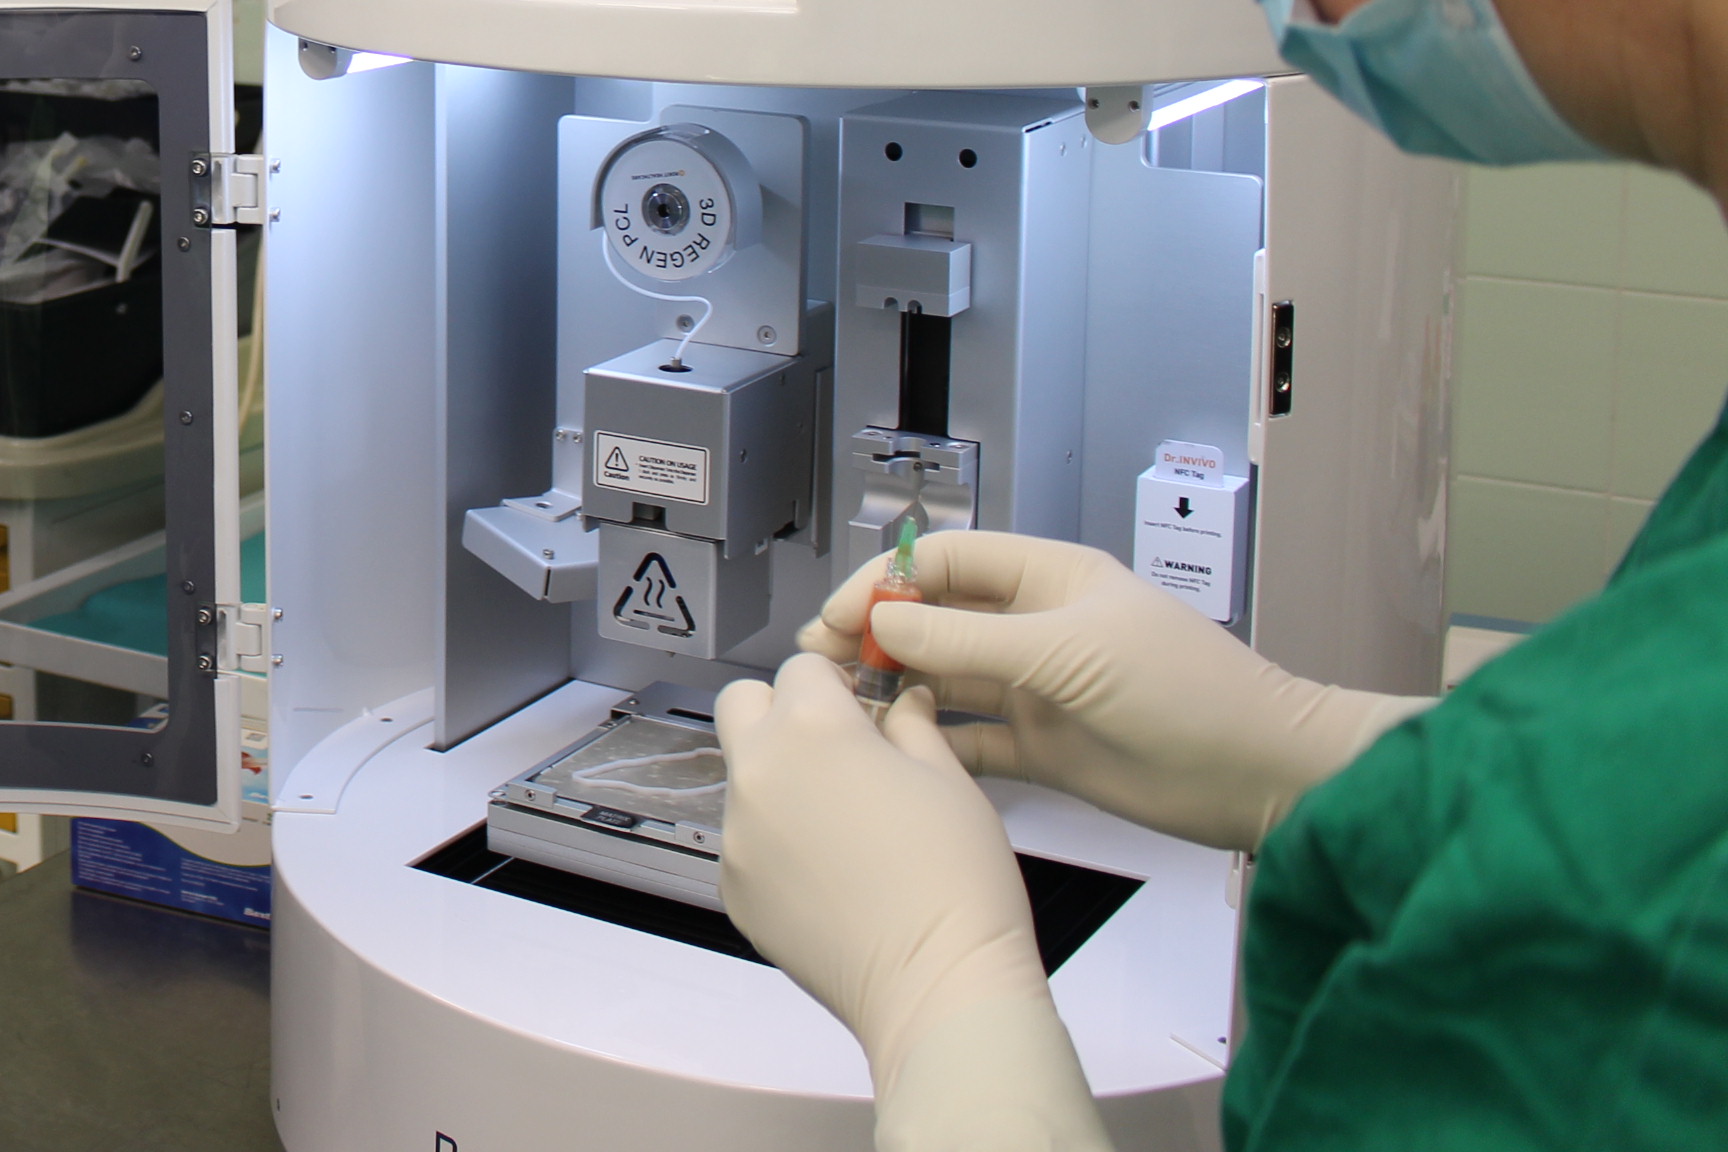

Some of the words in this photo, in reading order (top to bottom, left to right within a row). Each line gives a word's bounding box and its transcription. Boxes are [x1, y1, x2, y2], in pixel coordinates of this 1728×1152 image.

[699, 198, 717, 227] 3D
[613, 203, 639, 247] PCL
[639, 233, 711, 268] REGEN
[638, 455, 665, 465] CAUTION
[677, 461, 697, 470] USAGE
[604, 471, 630, 481] Caution
[1174, 468, 1191, 476] NFC
[1191, 470, 1205, 480] Tag
[1164, 559, 1212, 575] WARNING
